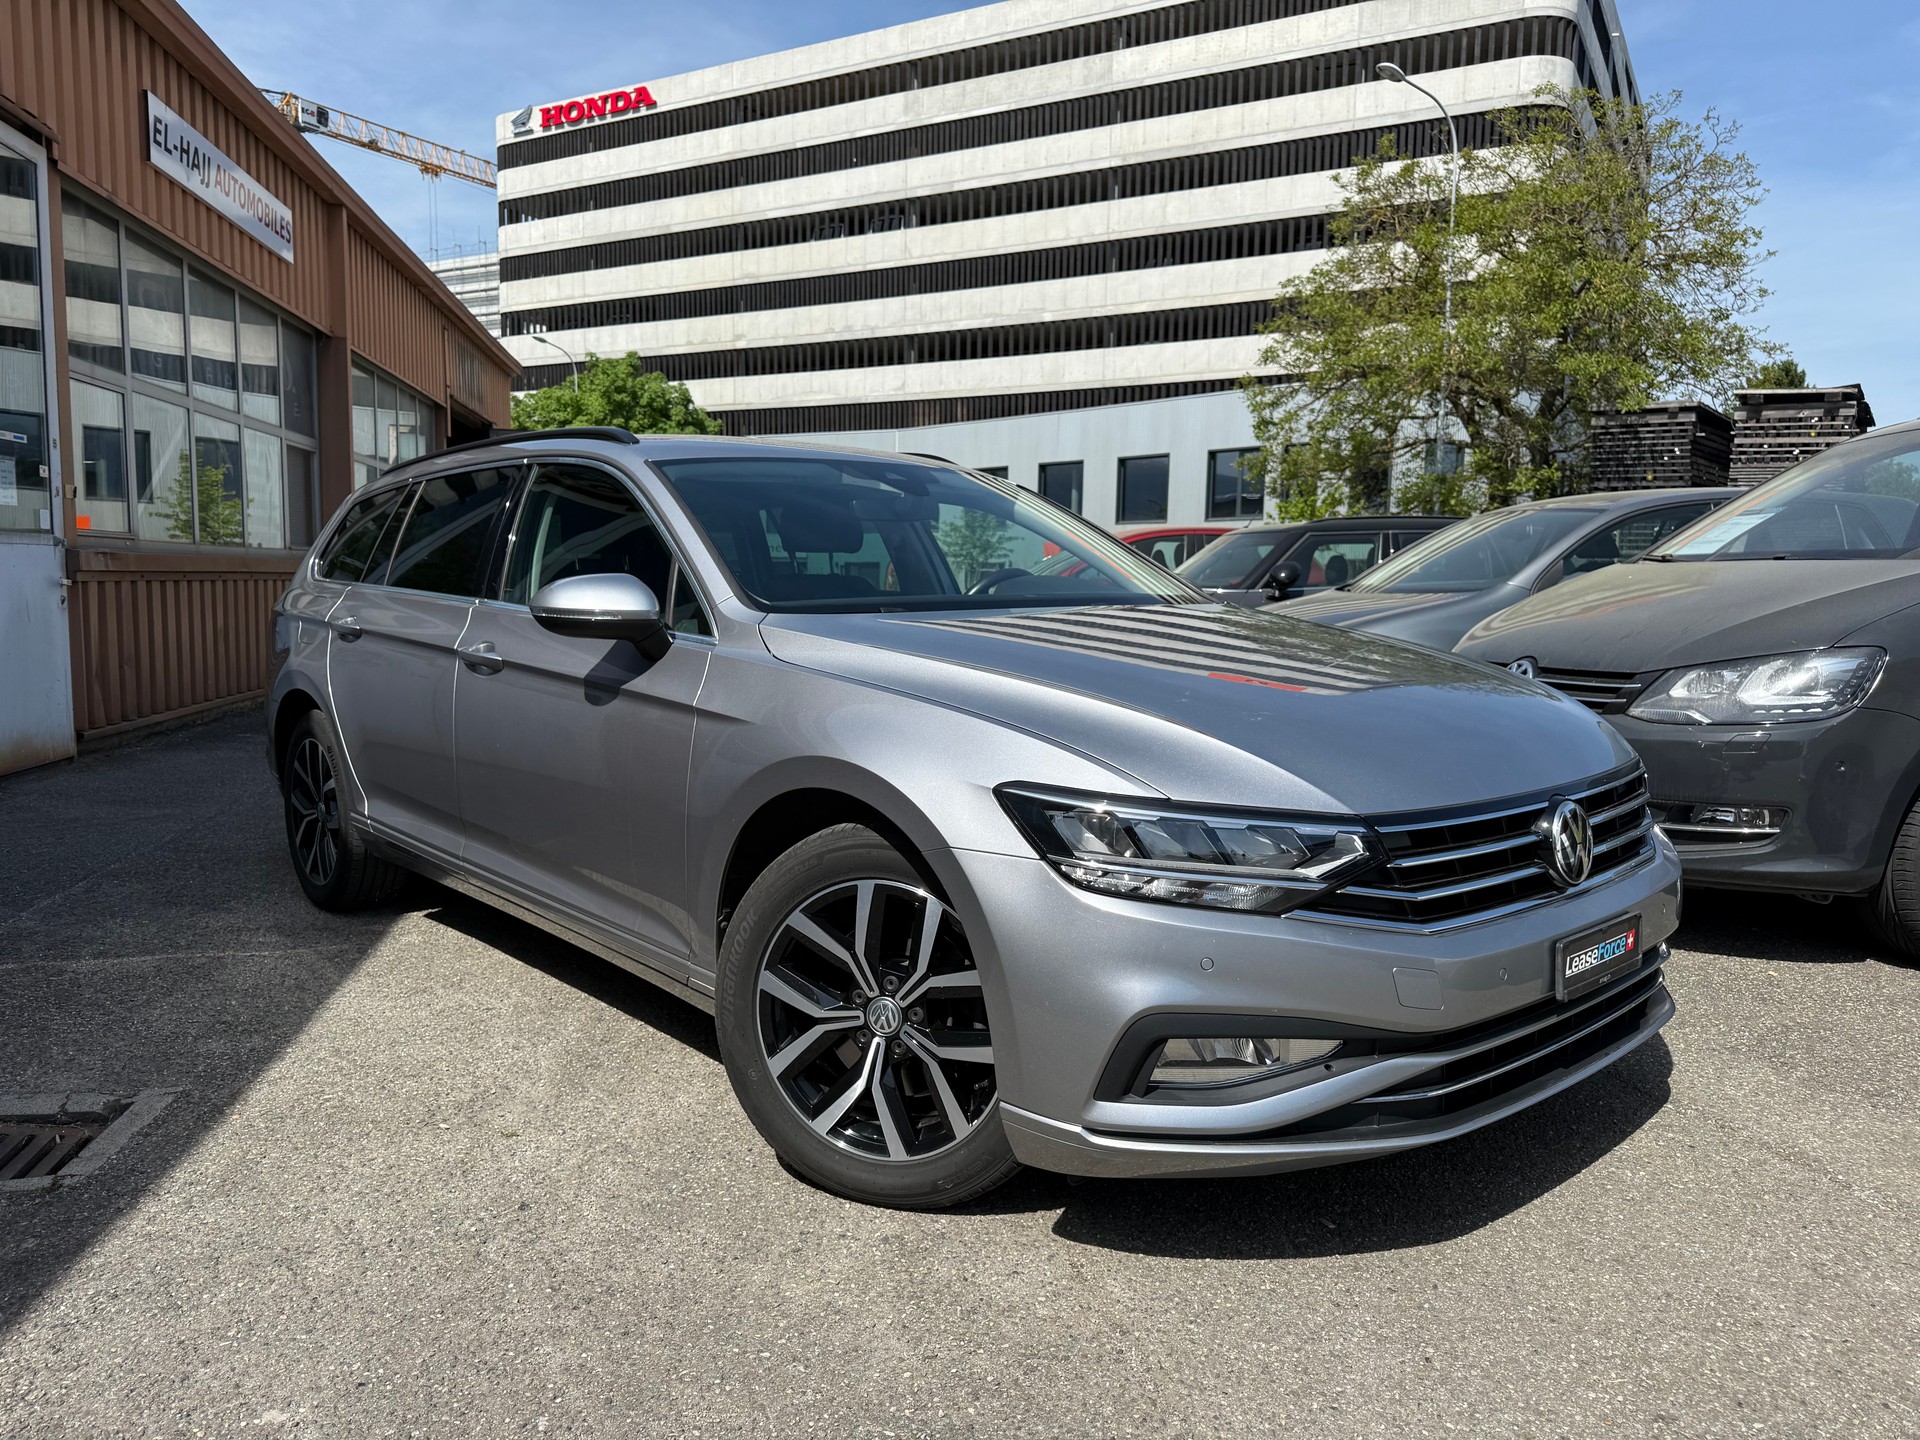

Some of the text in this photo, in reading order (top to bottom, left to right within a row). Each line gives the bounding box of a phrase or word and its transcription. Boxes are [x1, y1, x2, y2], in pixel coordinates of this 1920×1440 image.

[540, 86, 656, 127] HONDA
[153, 115, 292, 244] EL-HAJJ AUTOMOBILES
[1566, 936, 1626, 976] LeaseForce
